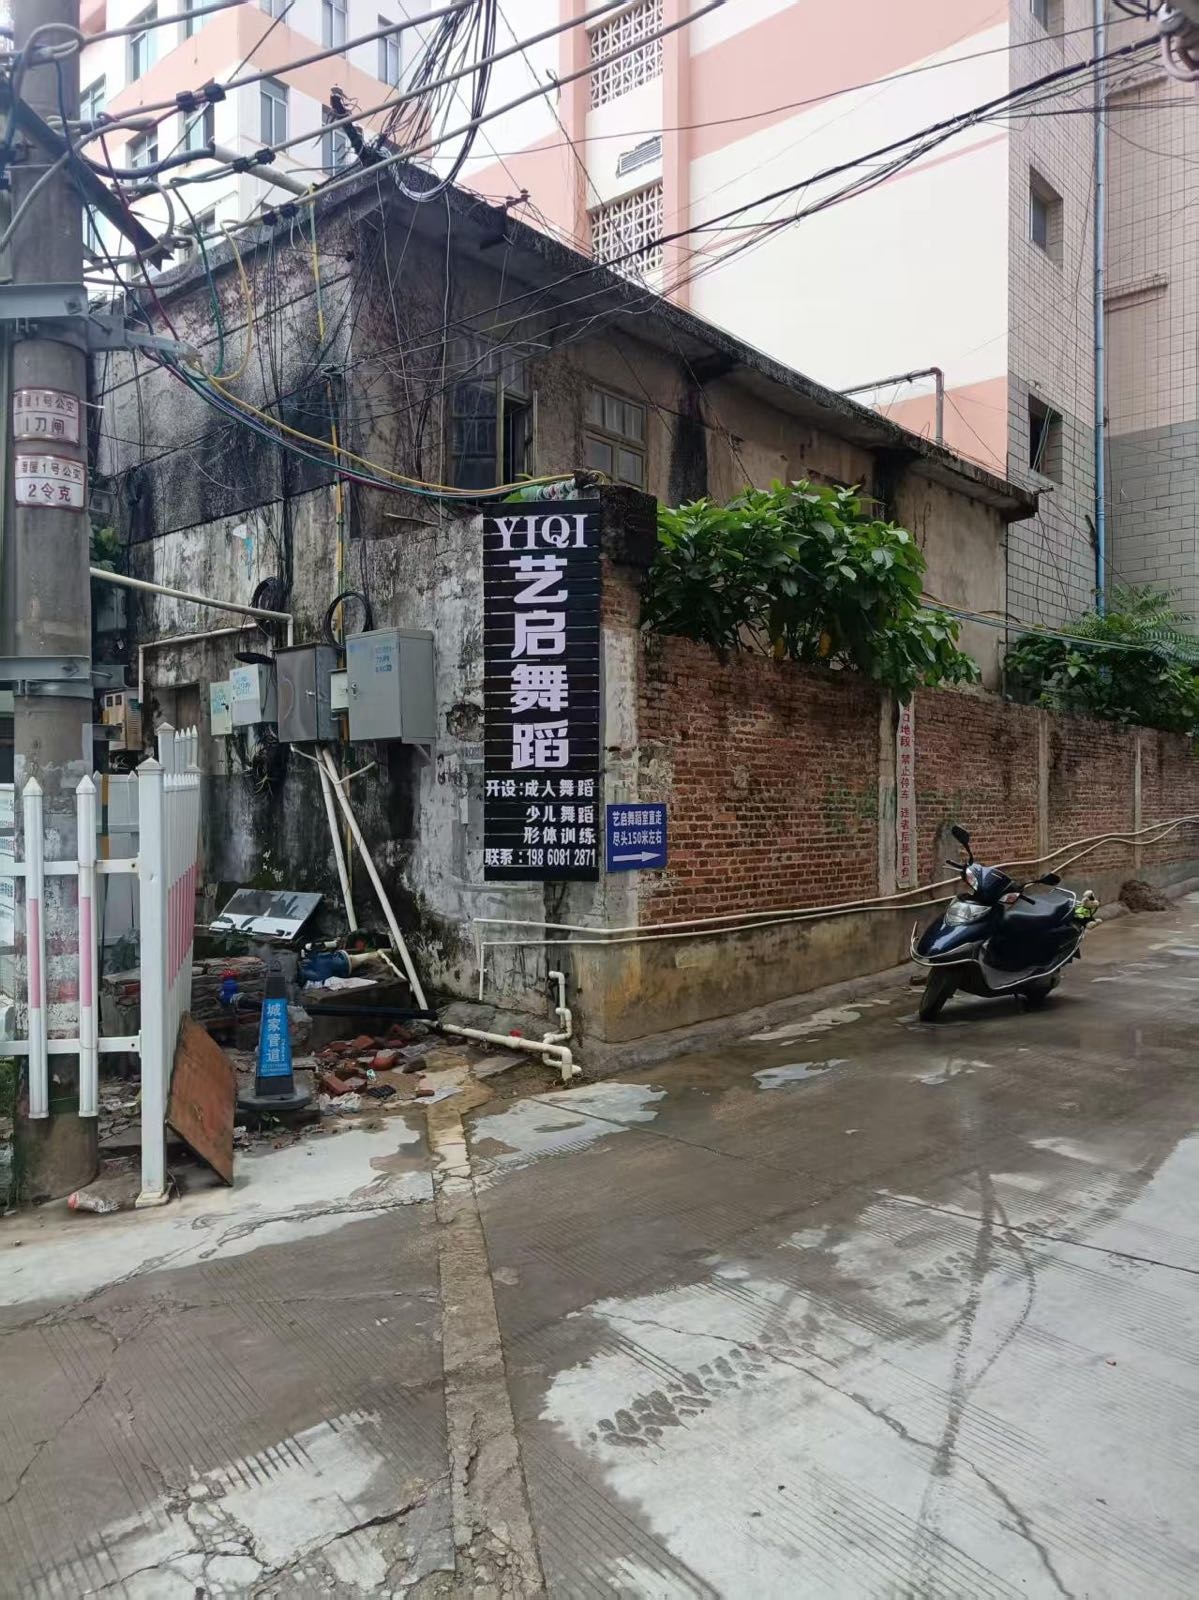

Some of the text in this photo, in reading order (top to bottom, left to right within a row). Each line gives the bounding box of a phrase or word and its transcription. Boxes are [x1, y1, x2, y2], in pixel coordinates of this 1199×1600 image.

[28, 482, 71, 502] 2令克
[494, 514, 588, 550] YIQI
[510, 554, 569, 770] 艺启舞蹈
[525, 804, 595, 824] 少儿舞蹈
[611, 810, 663, 827] 艺启舞蹈室直走
[523, 826, 597, 845] 形体训练
[612, 829, 663, 847] 尽头150米左右
[547, 848, 571, 867] 6081
[573, 848, 597, 867] 2871
